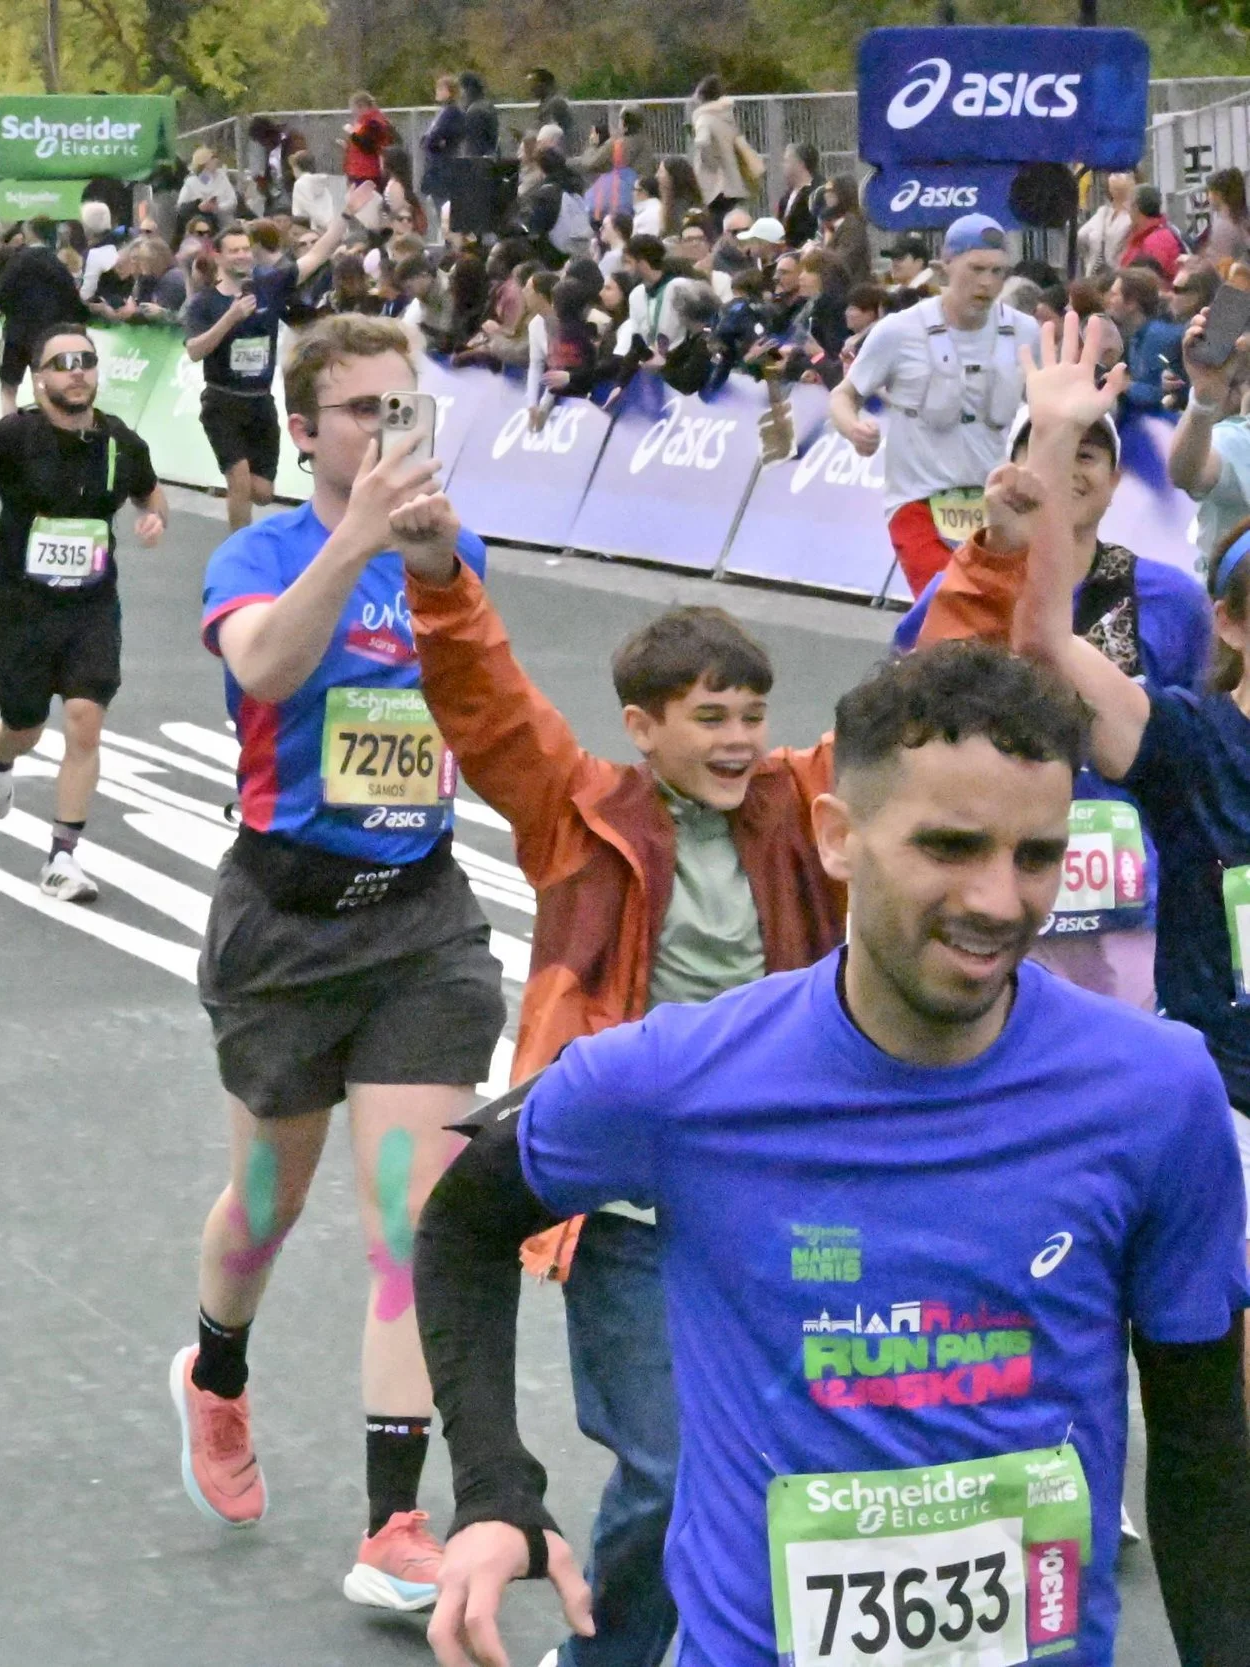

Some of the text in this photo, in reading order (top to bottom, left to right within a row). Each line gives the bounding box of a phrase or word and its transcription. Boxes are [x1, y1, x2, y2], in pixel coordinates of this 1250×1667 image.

[952, 72, 1081, 118] asics
[1, 114, 141, 140] Schneider
[61, 141, 139, 156] Electric
[918, 186, 979, 208] asics
[662, 416, 738, 470] asics
[38, 542, 87, 566] 73315
[339, 732, 434, 778] 72766
[367, 783, 406, 797] SAMOS
[385, 811, 427, 828] asics
[1055, 914, 1101, 933] asics
[803, 1335, 929, 1380] RUN
[806, 1470, 996, 1514] Schneider
[892, 1501, 991, 1530] Electric
[806, 1551, 1010, 1657] 73633
